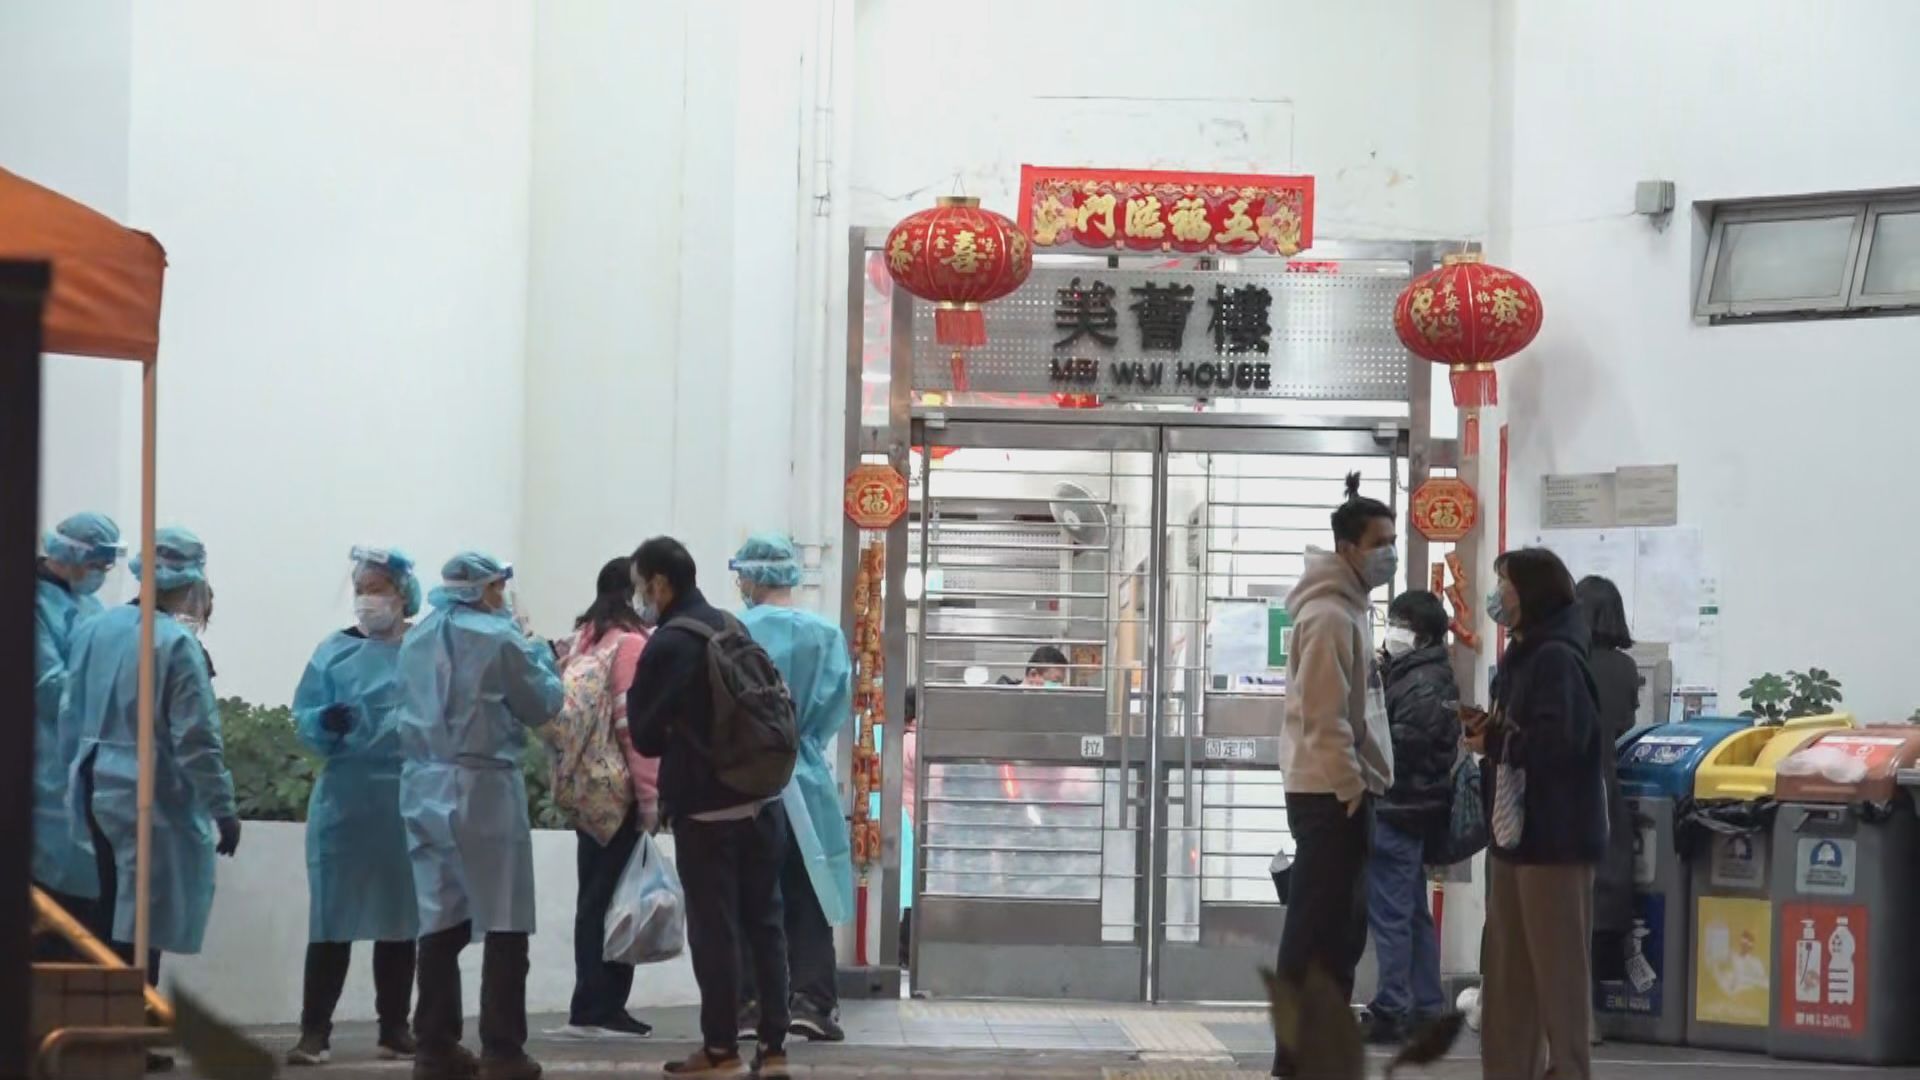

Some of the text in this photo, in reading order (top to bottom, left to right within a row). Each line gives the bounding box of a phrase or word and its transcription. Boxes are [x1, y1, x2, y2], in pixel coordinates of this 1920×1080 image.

[1051, 358, 1272, 390] MEI WUI HOUSE
[861, 487, 890, 513] 福
[1430, 501, 1460, 528] 福
